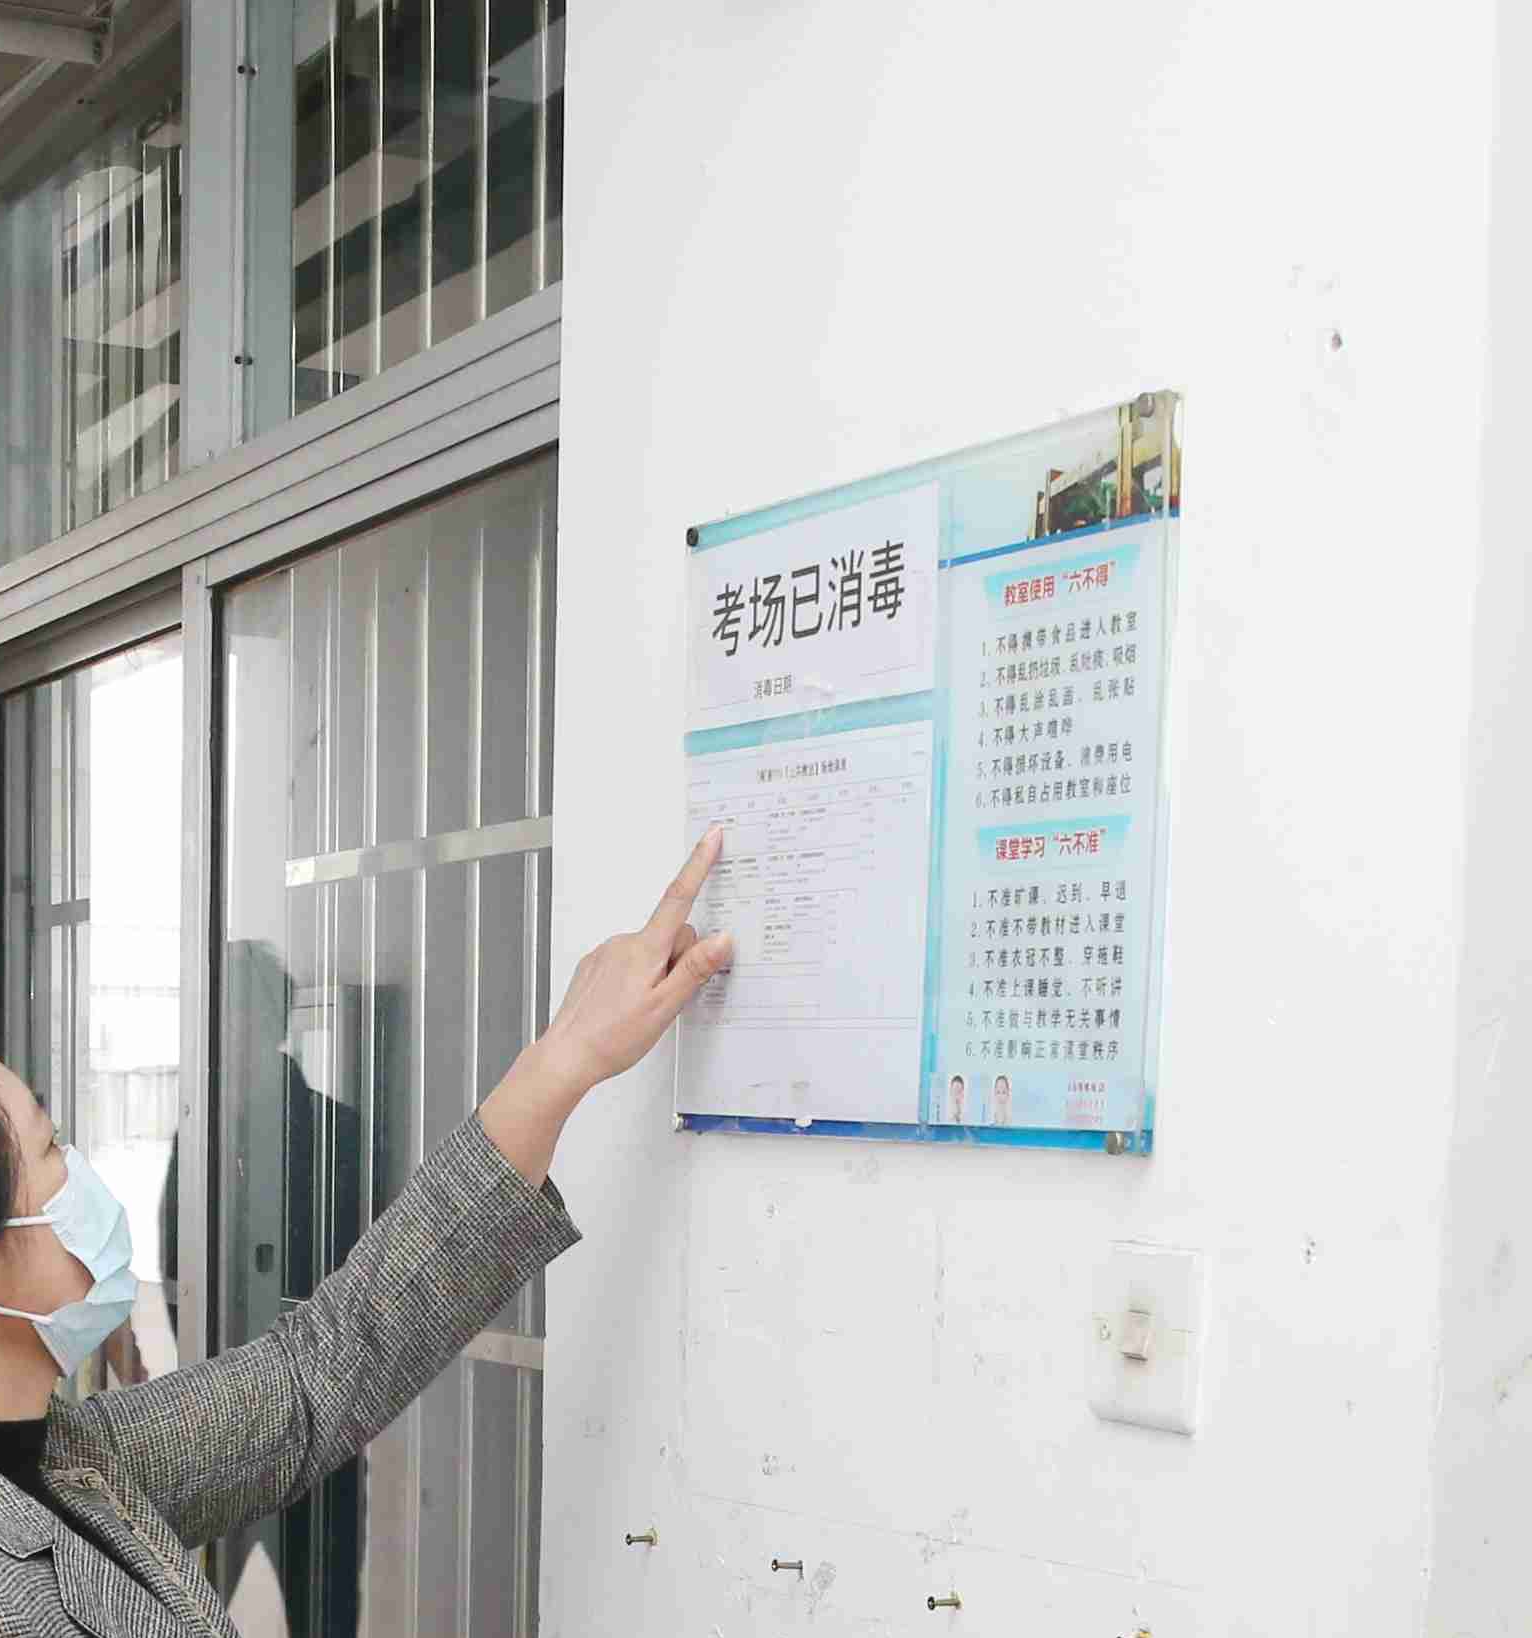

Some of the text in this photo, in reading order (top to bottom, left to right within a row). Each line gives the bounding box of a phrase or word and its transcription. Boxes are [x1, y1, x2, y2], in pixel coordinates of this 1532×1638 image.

[711, 539, 906, 659] 考场已消毒
